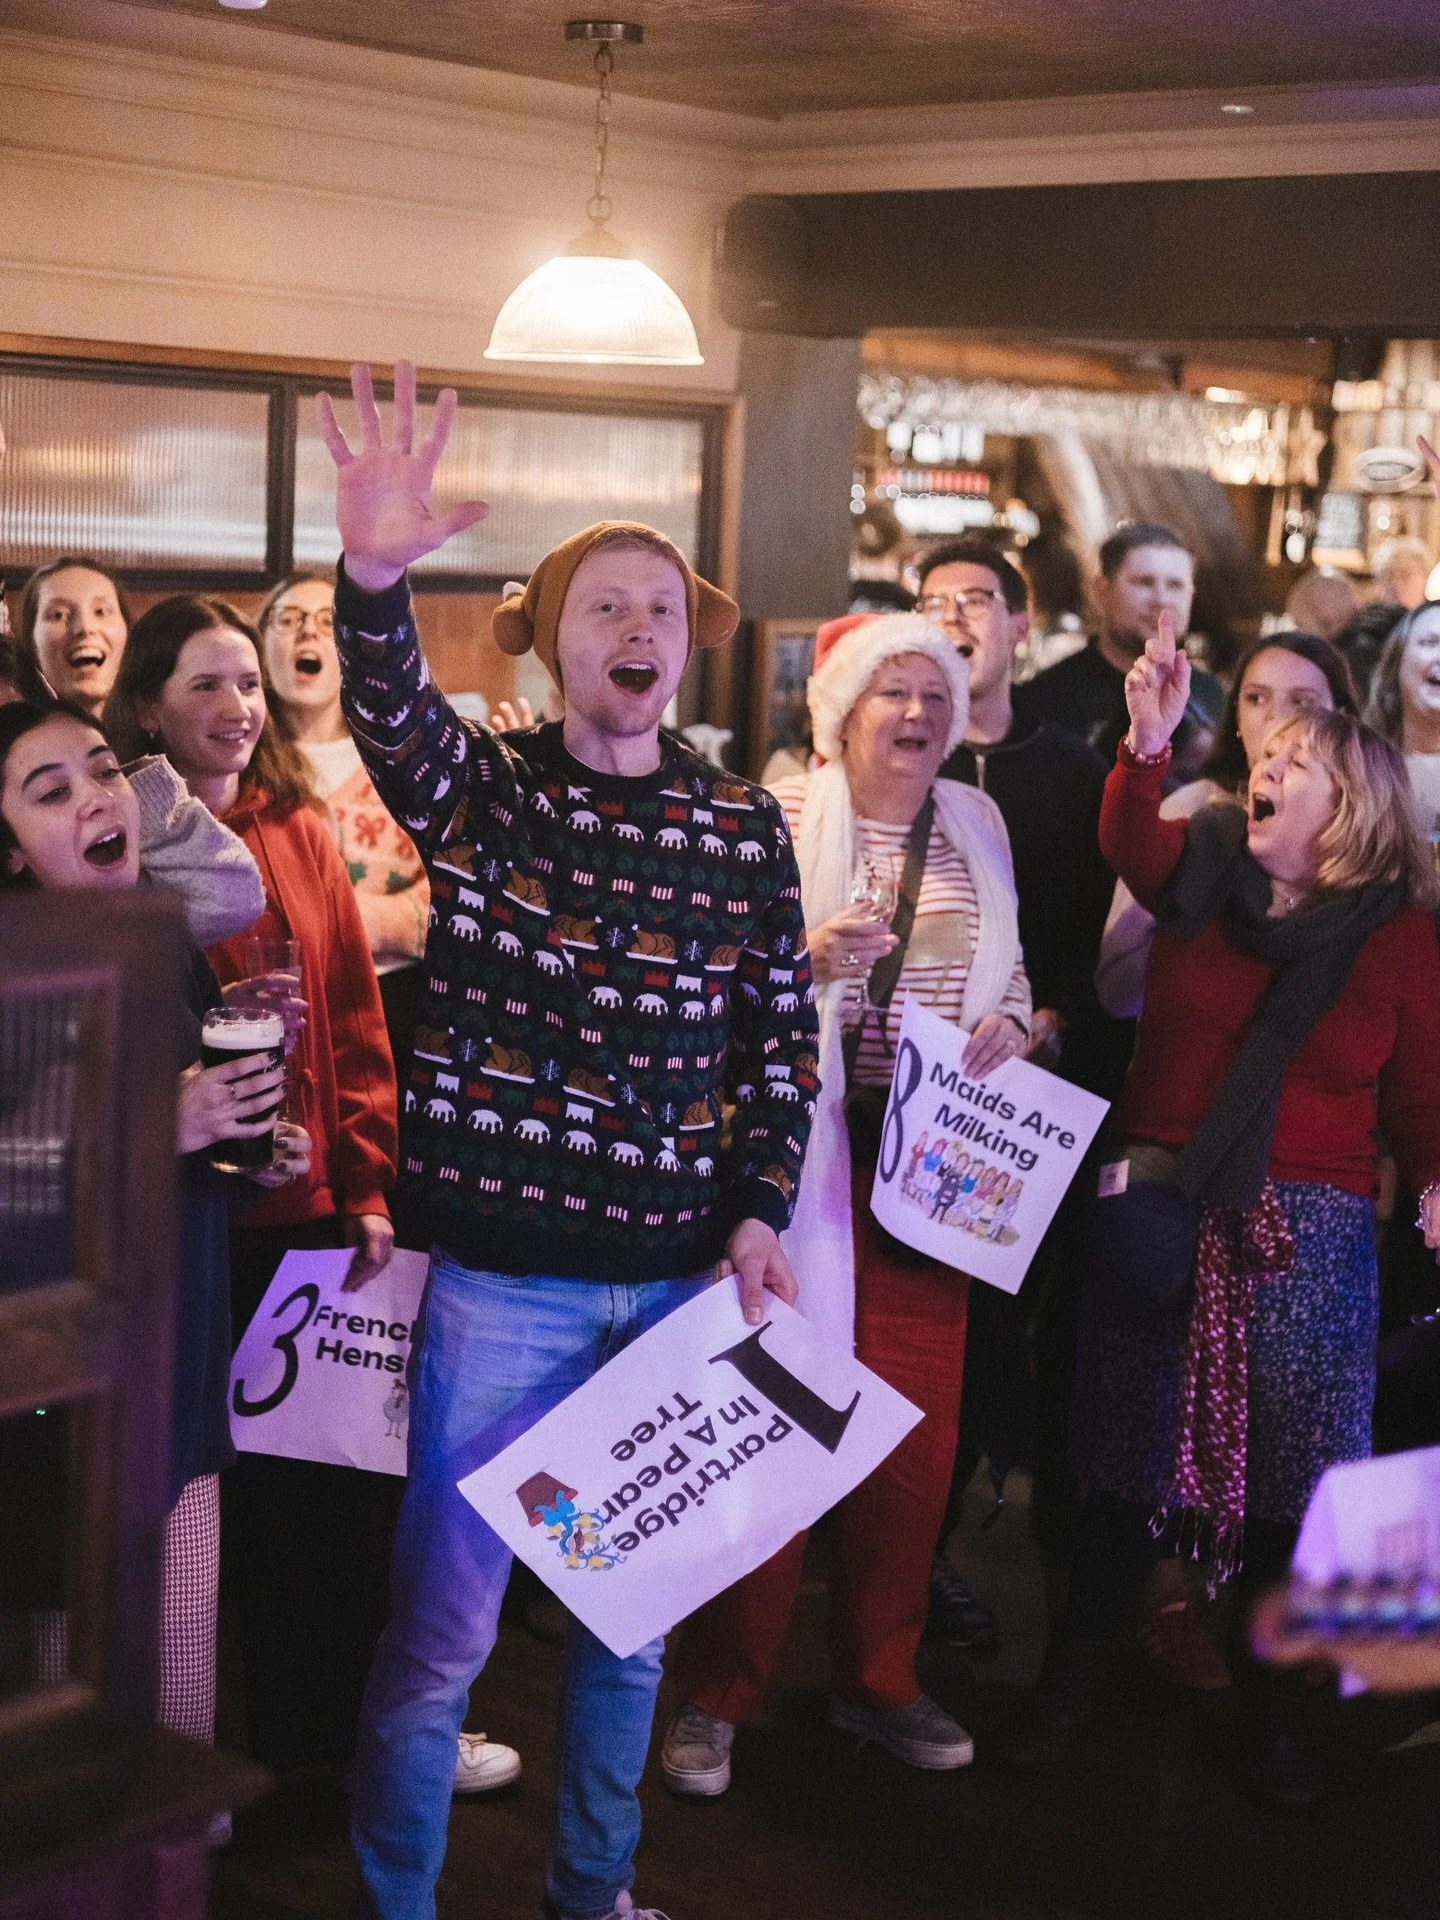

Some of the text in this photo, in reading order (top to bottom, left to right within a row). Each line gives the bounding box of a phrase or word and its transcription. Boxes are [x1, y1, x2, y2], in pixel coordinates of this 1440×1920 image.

[880, 1037, 922, 1184] 8
[929, 1062, 1076, 1150] Maids Are
[933, 1103, 1039, 1172] Milking
[232, 1282, 320, 1417] 3
[315, 1336, 405, 1374] Hens
[708, 1320, 862, 1455] 1
[602, 1394, 761, 1528] In A Pear
[610, 1391, 704, 1462] Tree
[612, 1412, 795, 1552] Partridge
